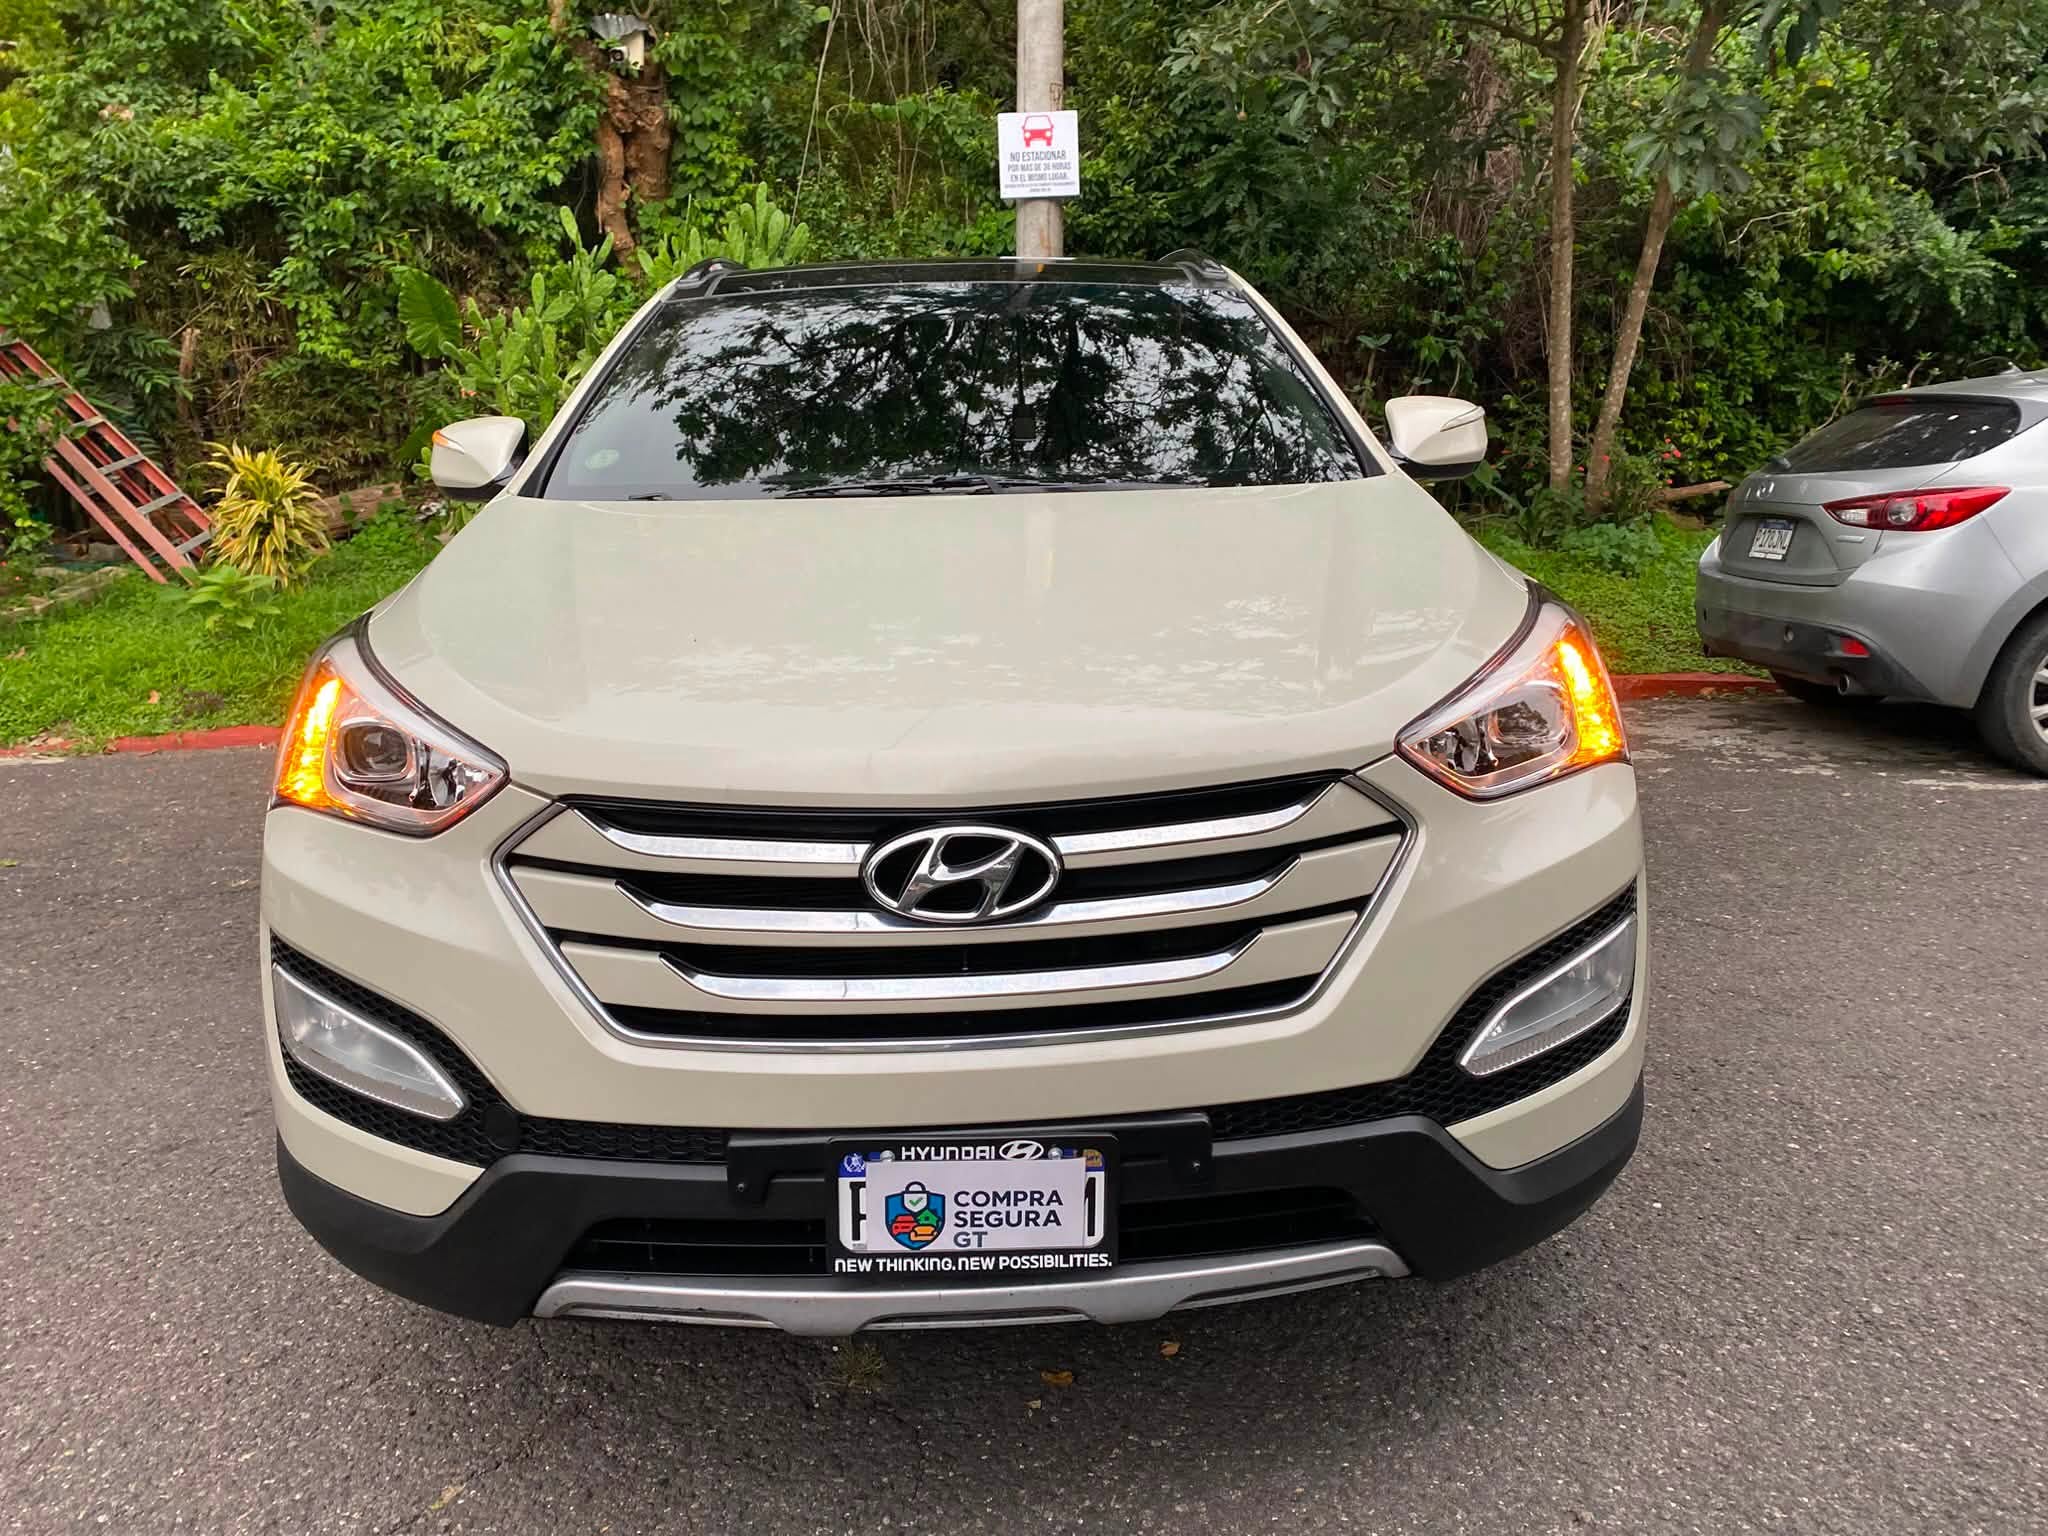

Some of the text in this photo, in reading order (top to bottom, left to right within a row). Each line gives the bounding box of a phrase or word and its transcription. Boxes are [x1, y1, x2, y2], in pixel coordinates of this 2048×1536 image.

[1010, 150, 1066, 162] NO ESTACIONAR
[1008, 163, 1019, 172] POR
[1052, 161, 1072, 170] HORAS
[1010, 174, 1019, 182] EN
[1020, 174, 1026, 182] EL
[901, 1146, 995, 1160] HYUNDAI
[953, 1190, 1063, 1207] COMPRA
[953, 1210, 1062, 1228] SEGURA
[953, 1231, 988, 1248] GT
[835, 1257, 872, 1272] NEW
[999, 1253, 1112, 1270] POSSIBILITIES.
